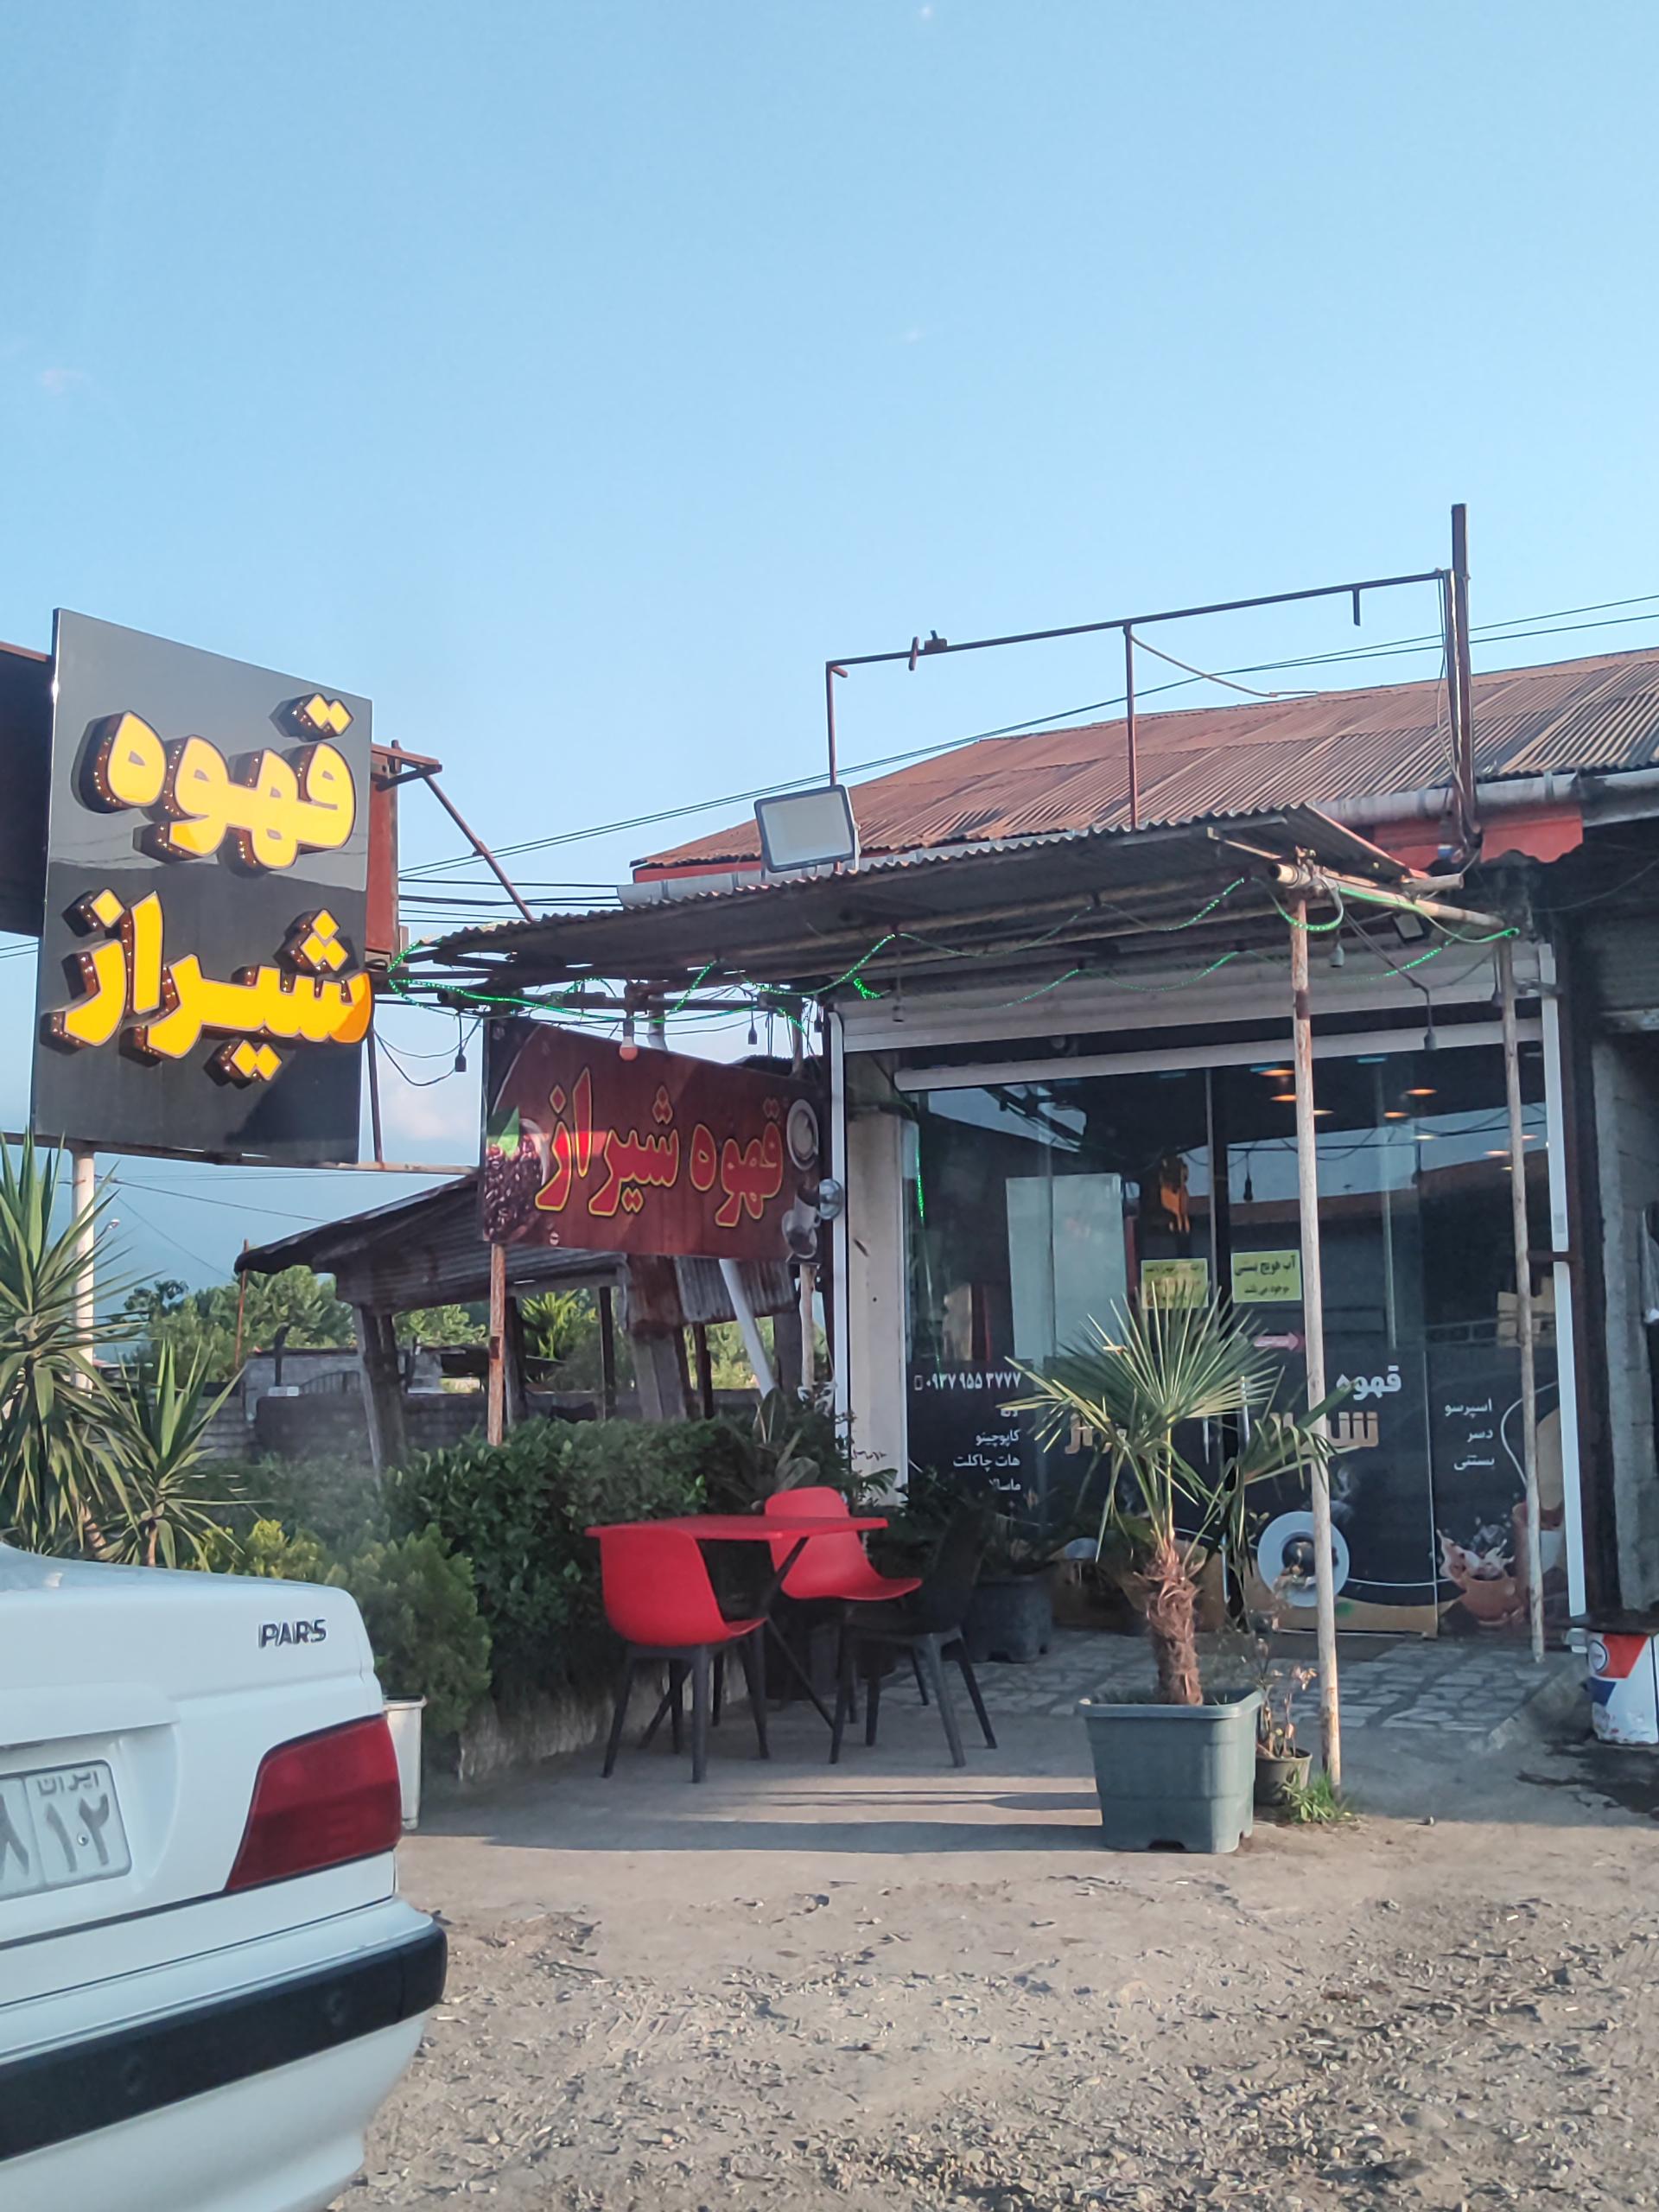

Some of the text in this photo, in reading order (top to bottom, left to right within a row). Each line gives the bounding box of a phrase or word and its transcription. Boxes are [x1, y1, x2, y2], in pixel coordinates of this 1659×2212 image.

[93, 693, 356, 870] قهوه
[57, 888, 372, 1082] شیراز
[534, 1066, 784, 1227] قهوه شیراز
[1445, 1397, 1493, 1419] اسپرسو
[976, 1428, 1021, 1447] کاپوچینو
[1466, 1428, 1494, 1443] دسر
[953, 1453, 1021, 1473] هات چاکلت
[1453, 1454, 1496, 1471] بستنی
[258, 1618, 327, 1649] PARS
[37, 1770, 99, 1797] ایران
[45, 1792, 111, 1874] ۱۲
